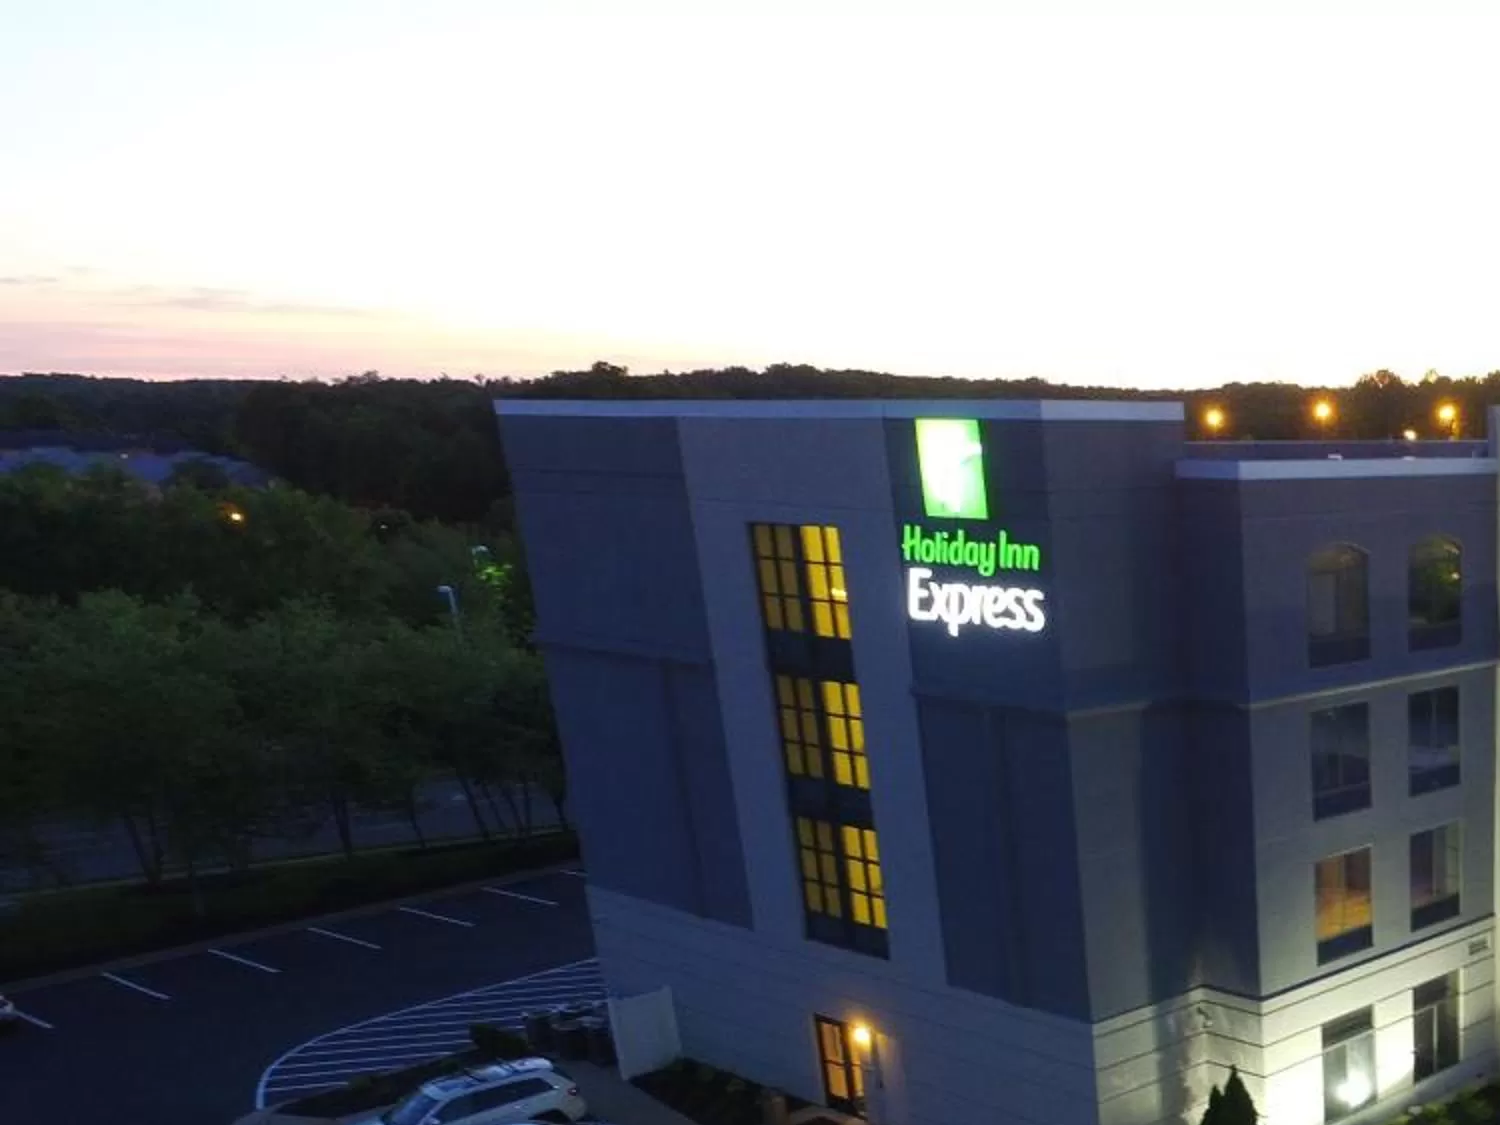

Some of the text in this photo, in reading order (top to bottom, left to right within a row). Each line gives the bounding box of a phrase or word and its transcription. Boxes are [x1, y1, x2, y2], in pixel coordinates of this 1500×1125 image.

[902, 524, 1041, 577] Holiday Inn
[908, 567, 1046, 637] Express
